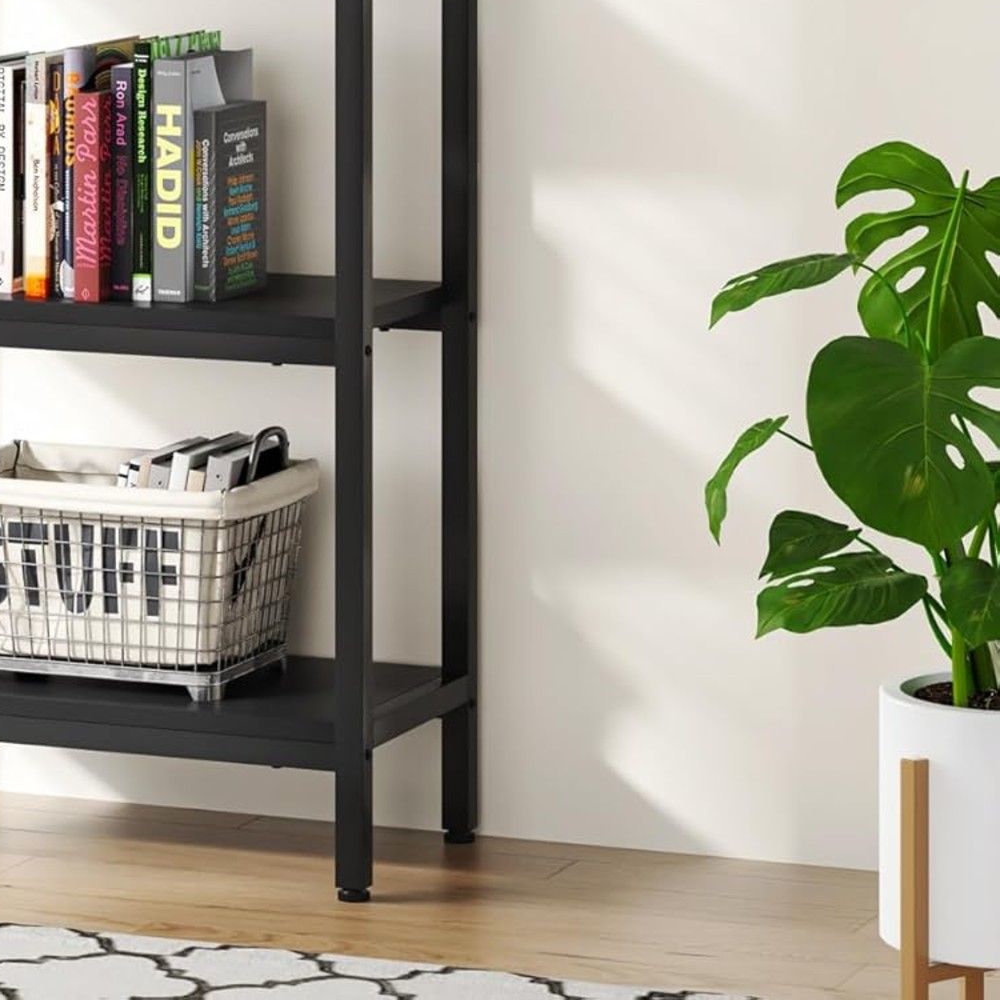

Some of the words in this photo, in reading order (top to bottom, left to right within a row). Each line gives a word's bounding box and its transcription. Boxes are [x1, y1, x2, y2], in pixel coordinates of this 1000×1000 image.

[115, 80, 128, 108] Ron
[135, 68, 147, 109] Design
[75, 97, 97, 163] Parr
[115, 112, 128, 146] Arad
[137, 110, 147, 164] Research
[32, 158, 41, 174] Ben
[156, 103, 182, 250] HADID
[201, 138, 210, 202] Conversations
[75, 170, 97, 265] Martin
[201, 203, 210, 222] with
[201, 223, 210, 268] Architects
